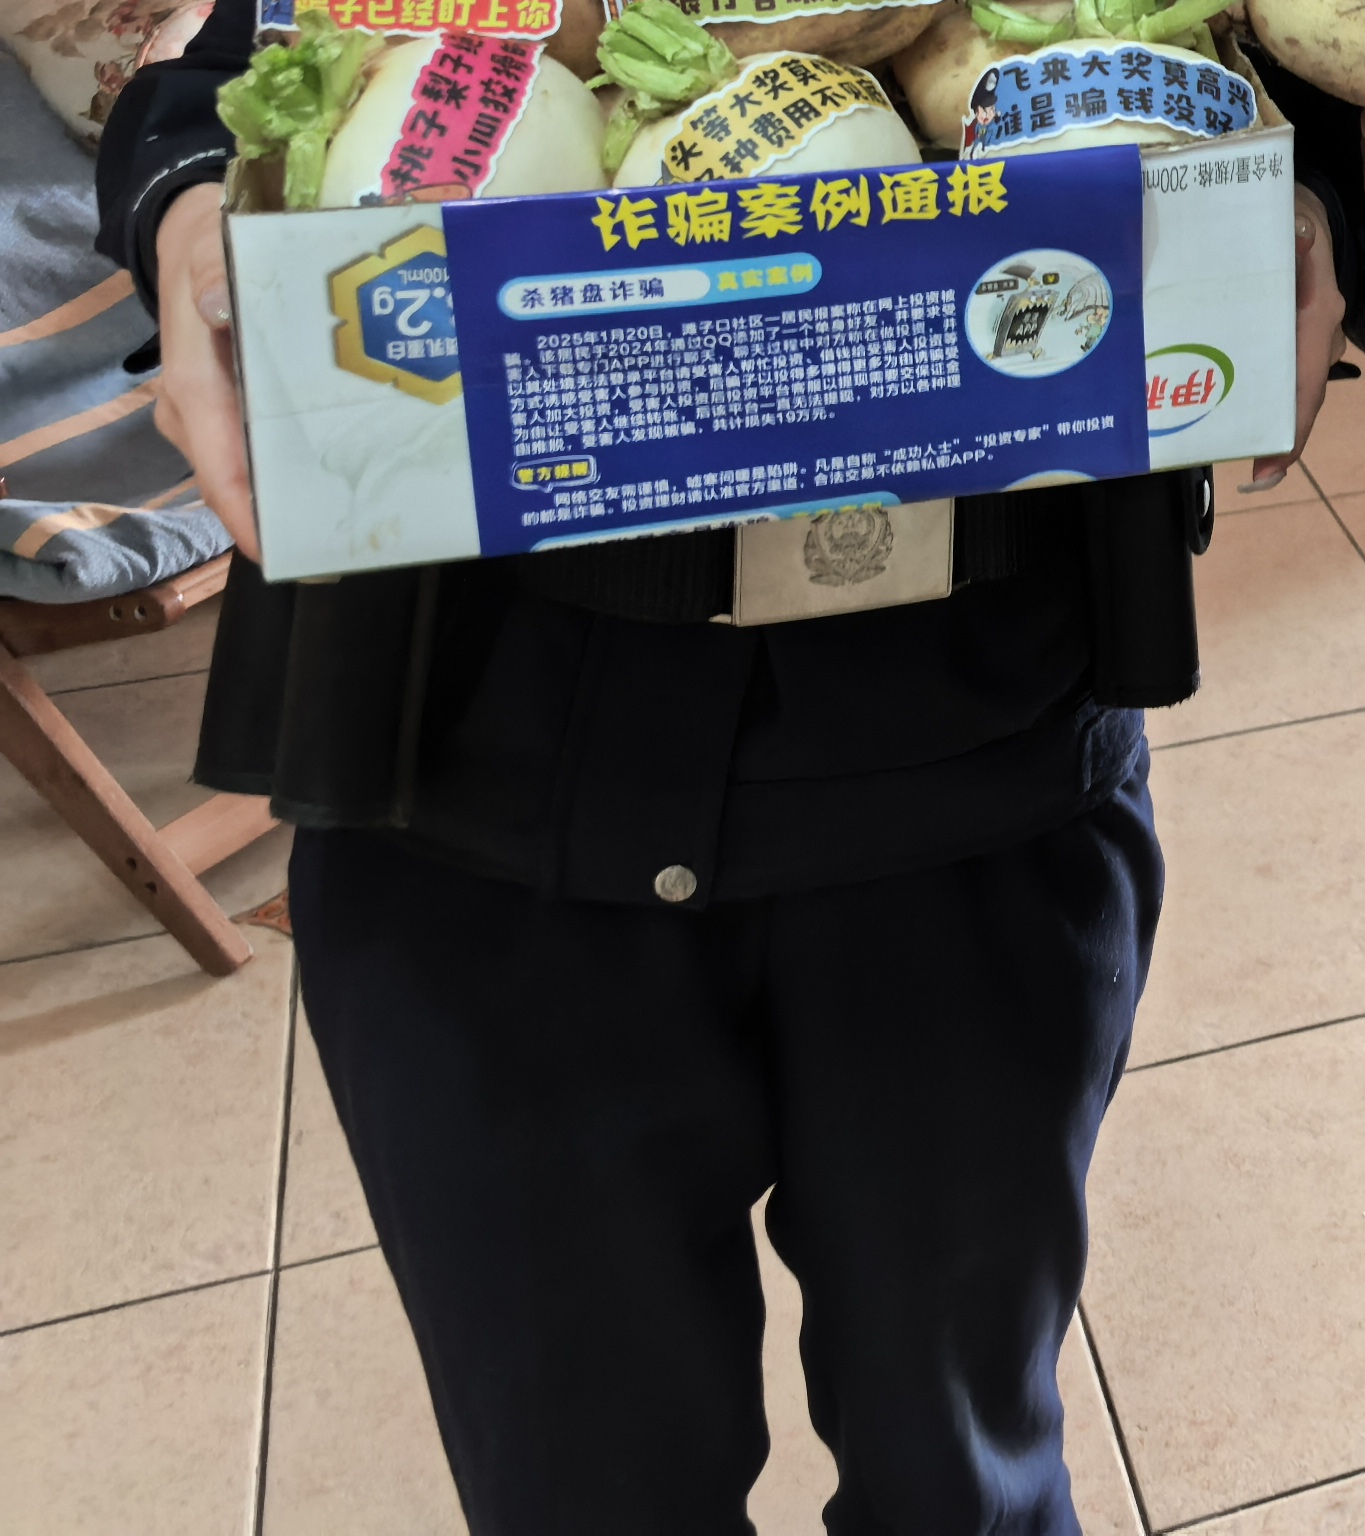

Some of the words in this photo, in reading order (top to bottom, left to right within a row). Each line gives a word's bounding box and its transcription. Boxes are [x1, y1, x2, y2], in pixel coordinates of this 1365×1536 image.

[1003, 52, 1250, 114] 飞来大奖莫高兴
[591, 161, 1008, 252] 诈骗案例通报
[521, 276, 665, 310] 杀猪盘诈骗
[717, 261, 814, 292] 真实案例
[372, 286, 455, 337] .2g
